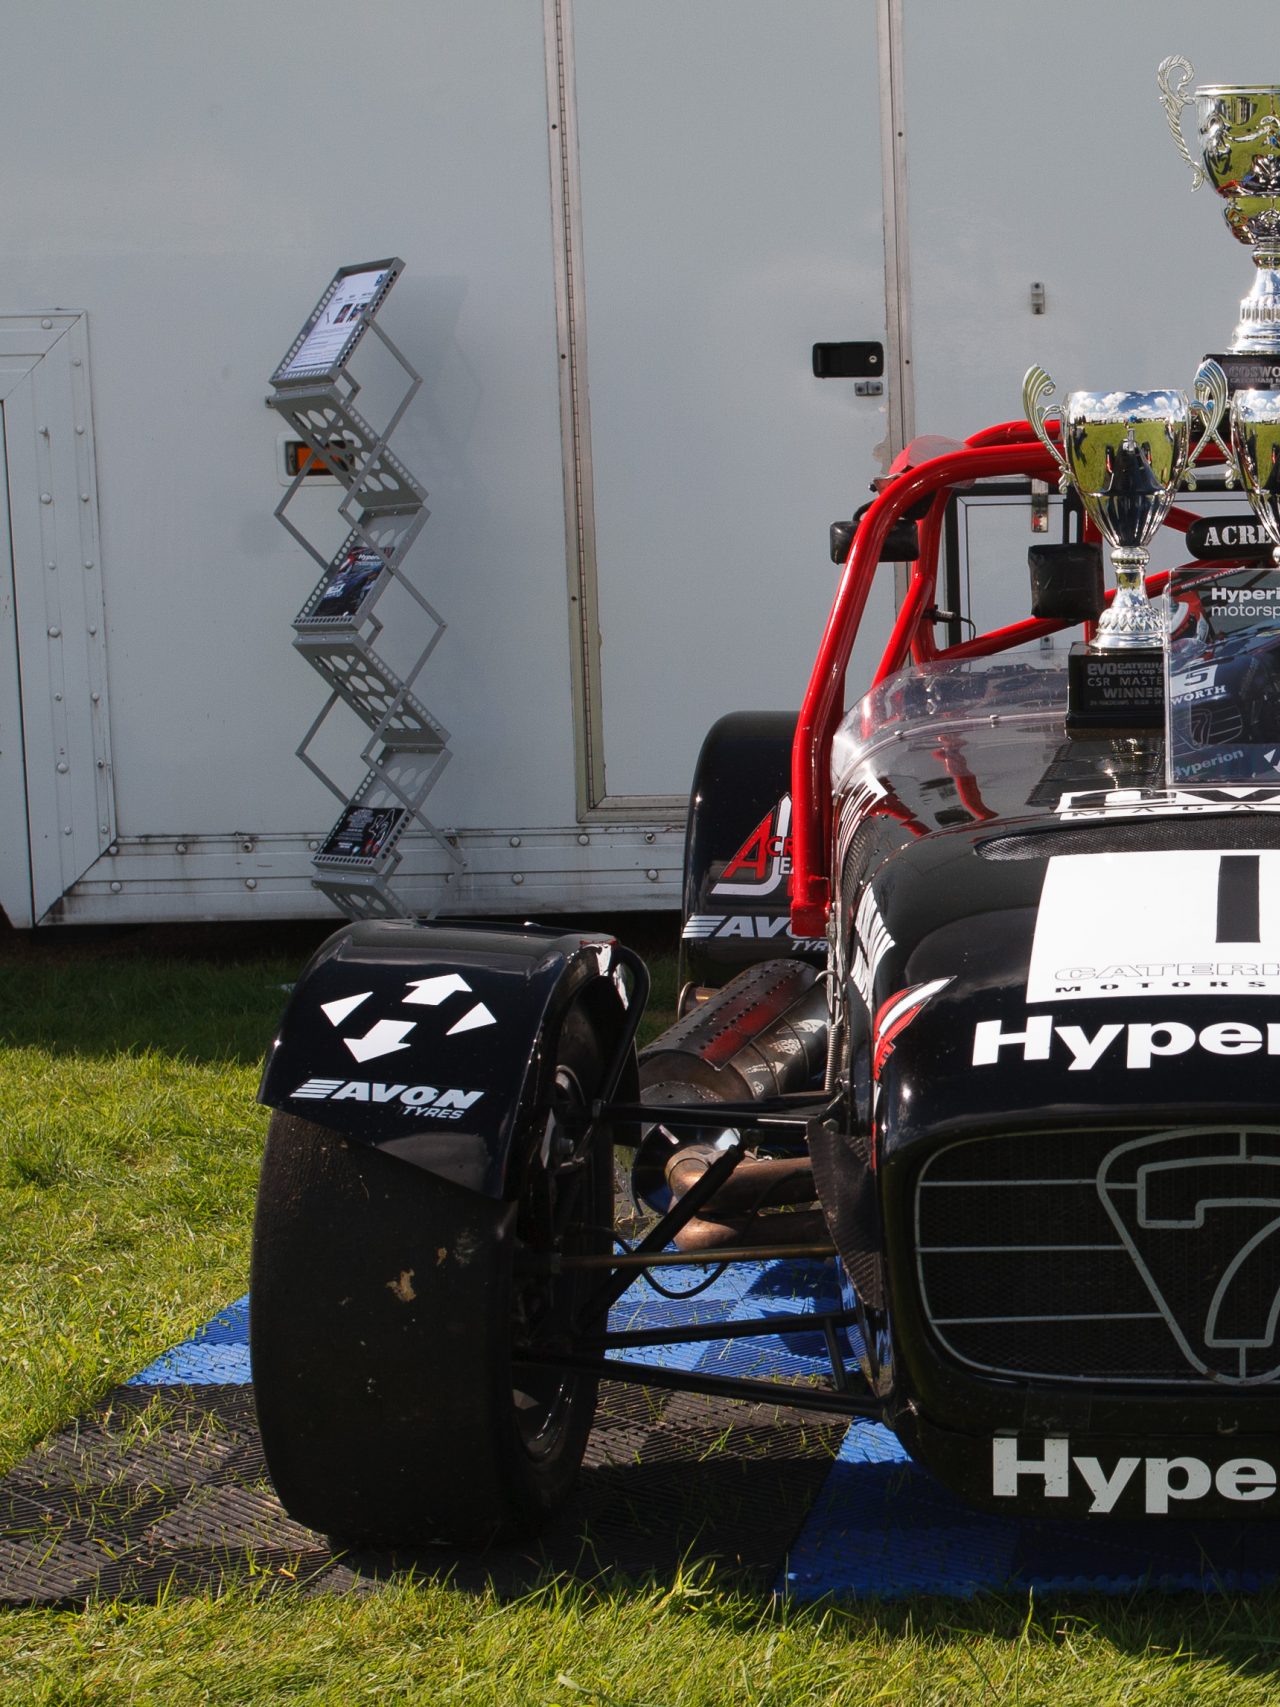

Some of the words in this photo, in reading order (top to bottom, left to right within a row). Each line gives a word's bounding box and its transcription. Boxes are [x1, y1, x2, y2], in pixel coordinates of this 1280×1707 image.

[1087, 676, 1111, 687] CSR
[1119, 676, 1164, 686] MASTE
[1184, 667, 1209, 686] 5
[331, 1081, 485, 1110] AVON
[402, 1105, 465, 1120] TYRES
